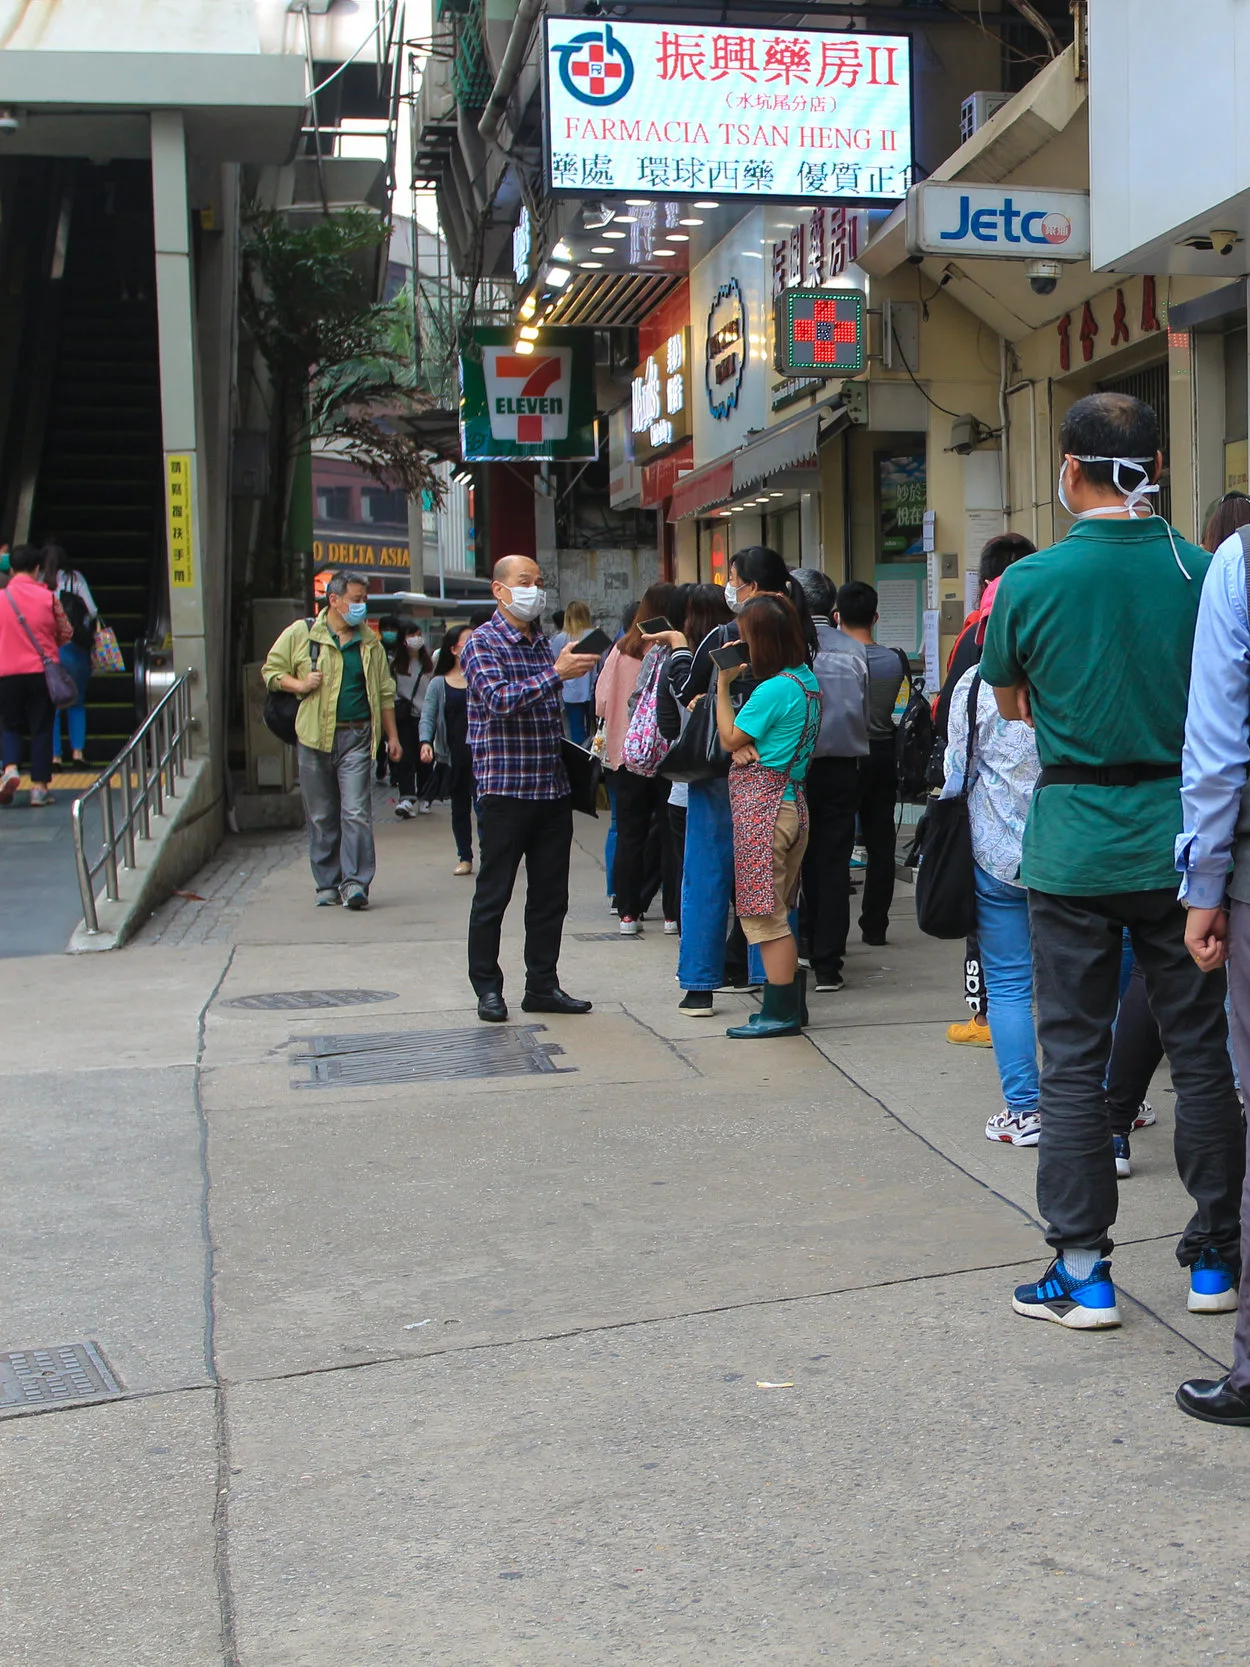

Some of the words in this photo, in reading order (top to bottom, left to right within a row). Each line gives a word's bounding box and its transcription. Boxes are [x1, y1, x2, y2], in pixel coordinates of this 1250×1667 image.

[564, 117, 709, 144] FARMACIA
[718, 123, 789, 147] TSAN
[798, 126, 872, 150] HENG
[880, 129, 898, 151] II
[636, 156, 775, 189] 環球西藥
[328, 543, 375, 565] DELTA
[379, 546, 411, 567] ASIA
